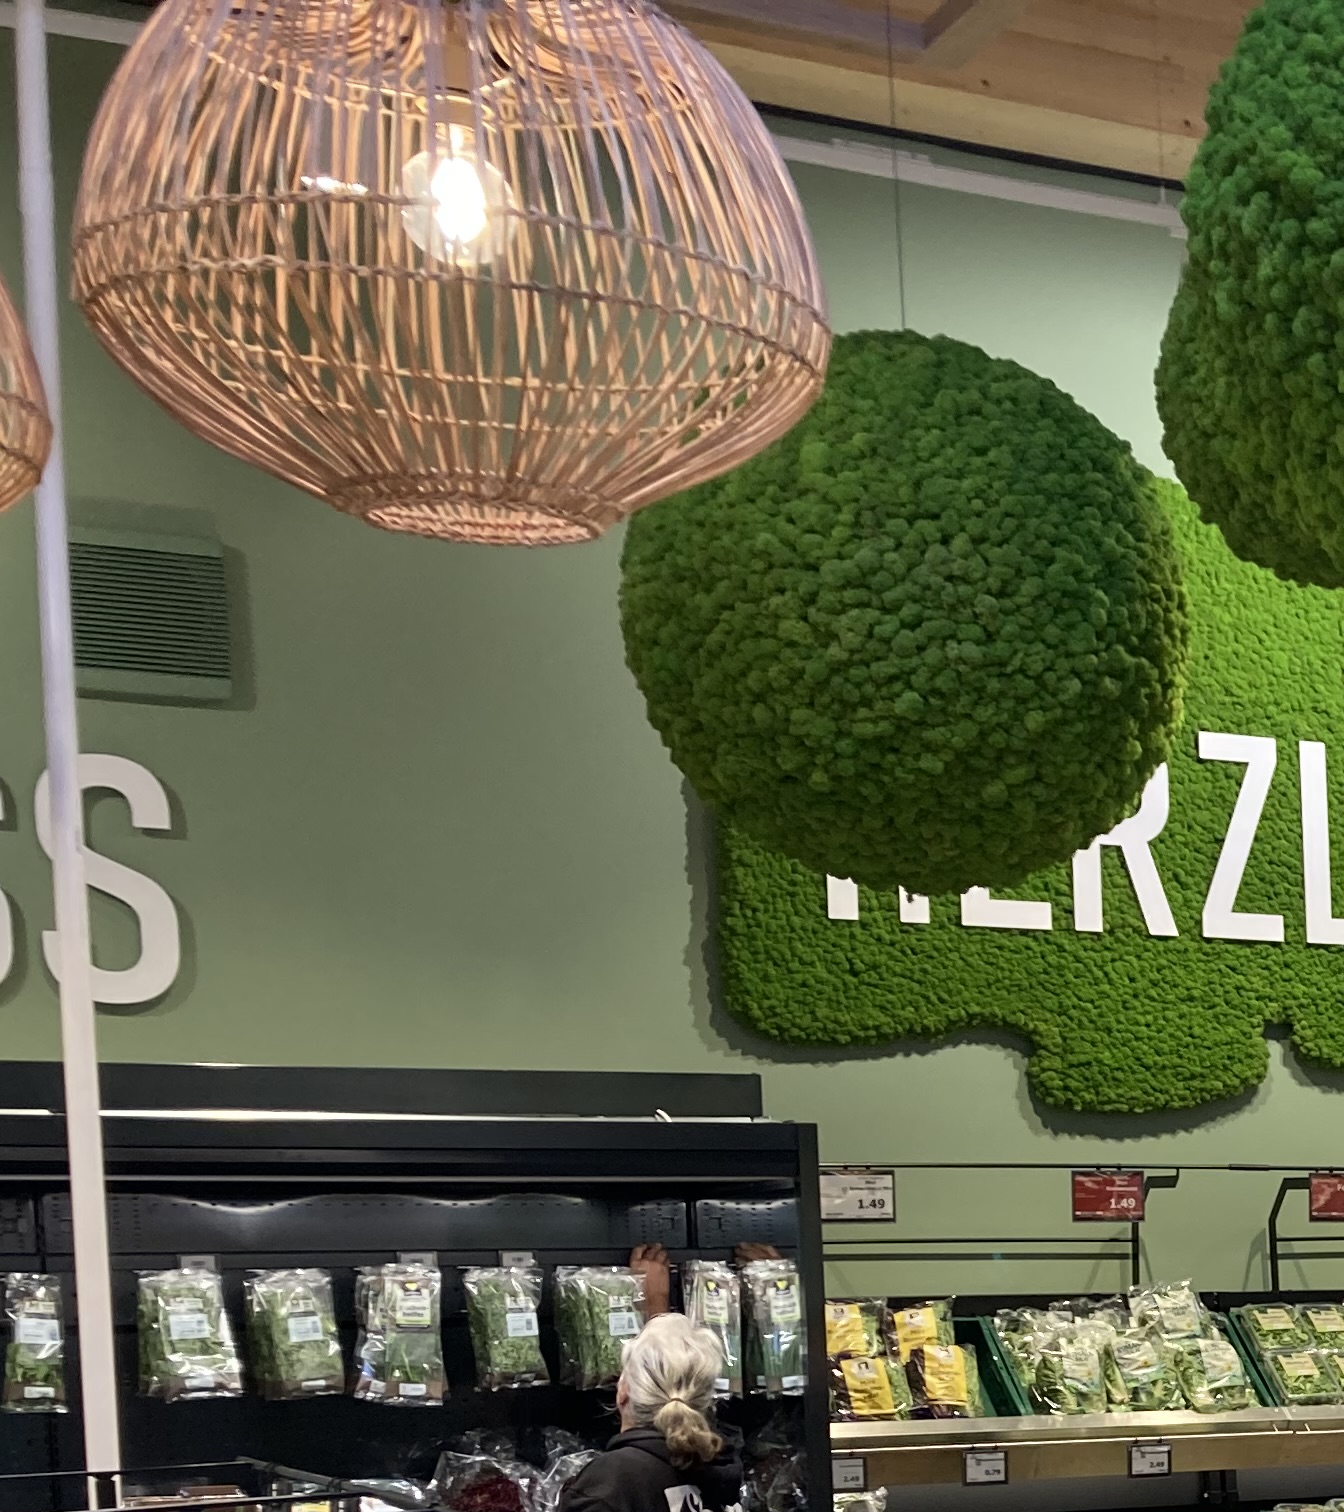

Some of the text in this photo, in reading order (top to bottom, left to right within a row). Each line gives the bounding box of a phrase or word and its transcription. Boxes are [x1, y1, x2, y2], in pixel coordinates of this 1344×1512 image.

[0, 753, 181, 1004] S
[857, 1198, 885, 1209] 1.49
[1109, 1198, 1136, 1209] 1.49
